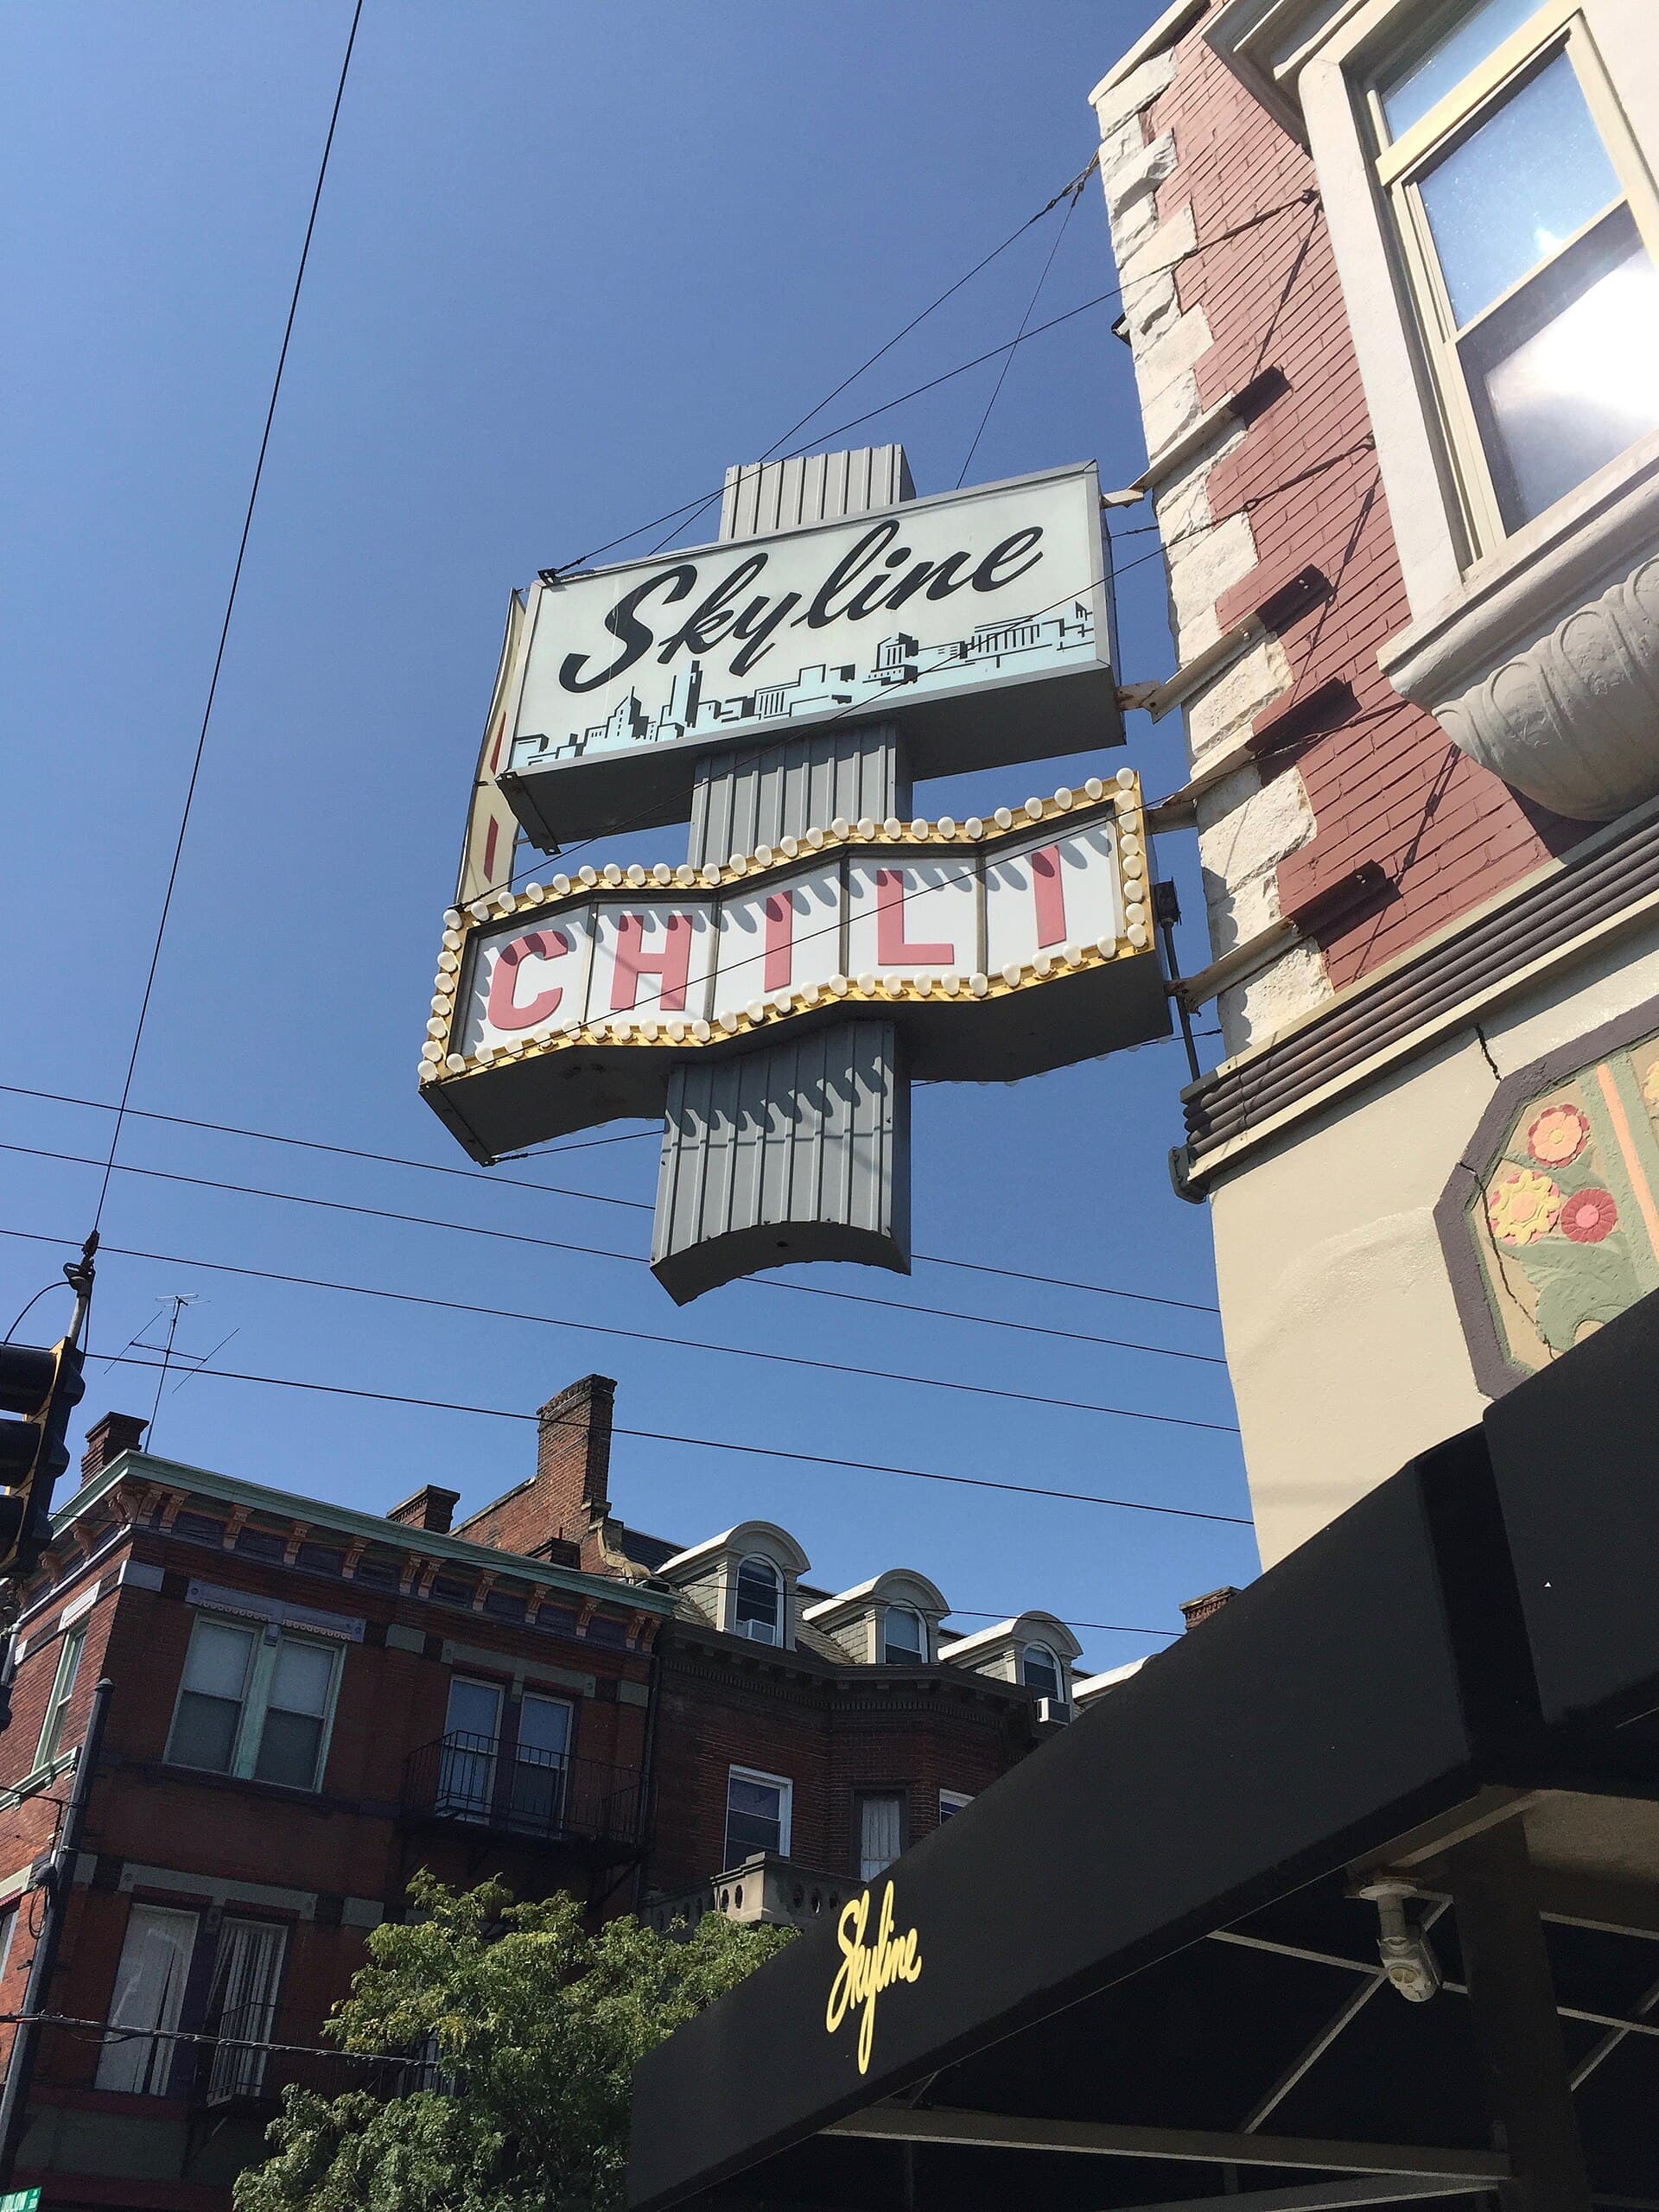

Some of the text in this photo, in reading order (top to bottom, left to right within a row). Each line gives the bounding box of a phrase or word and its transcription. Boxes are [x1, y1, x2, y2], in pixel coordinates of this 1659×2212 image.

[559, 518, 1044, 694] Skyline
[486, 845, 1067, 1031] CHILI
[826, 1879, 922, 2075] Skyline
